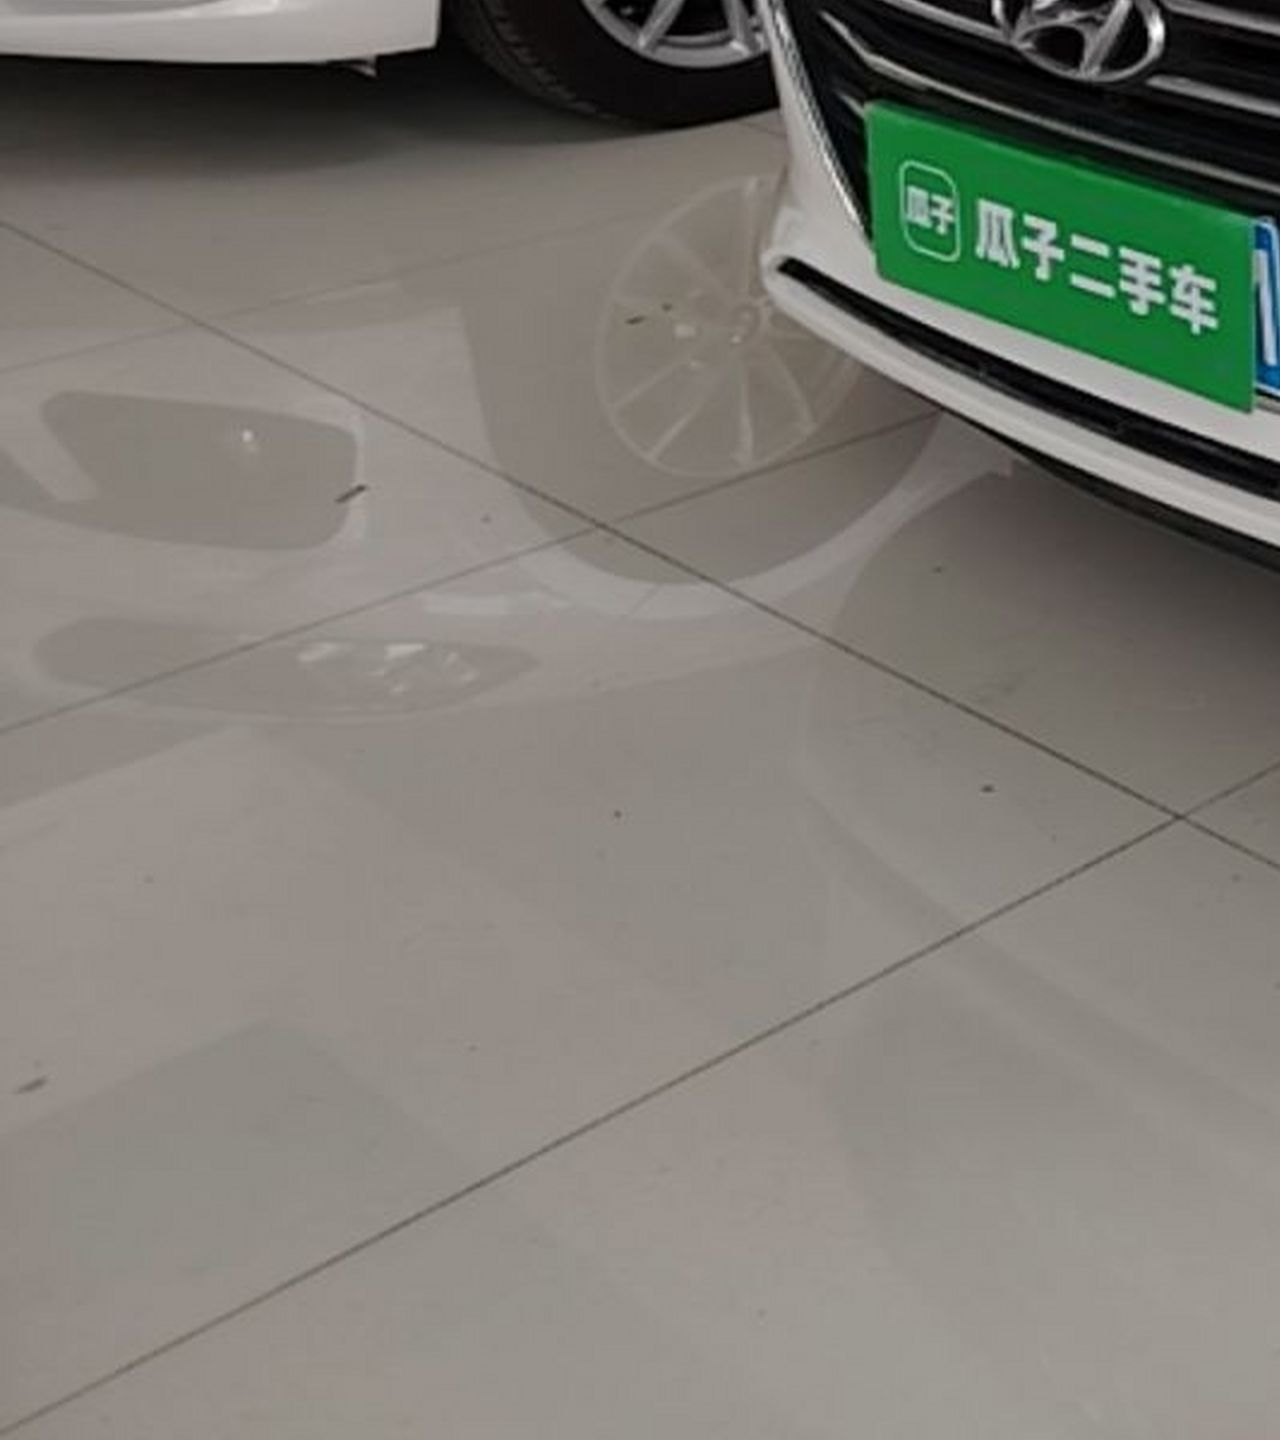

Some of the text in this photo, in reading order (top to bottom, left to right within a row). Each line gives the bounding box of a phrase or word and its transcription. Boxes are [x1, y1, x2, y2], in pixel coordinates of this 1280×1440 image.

[906, 185, 954, 235] 瓜子
[974, 197, 1219, 335] 瓜子二手车
